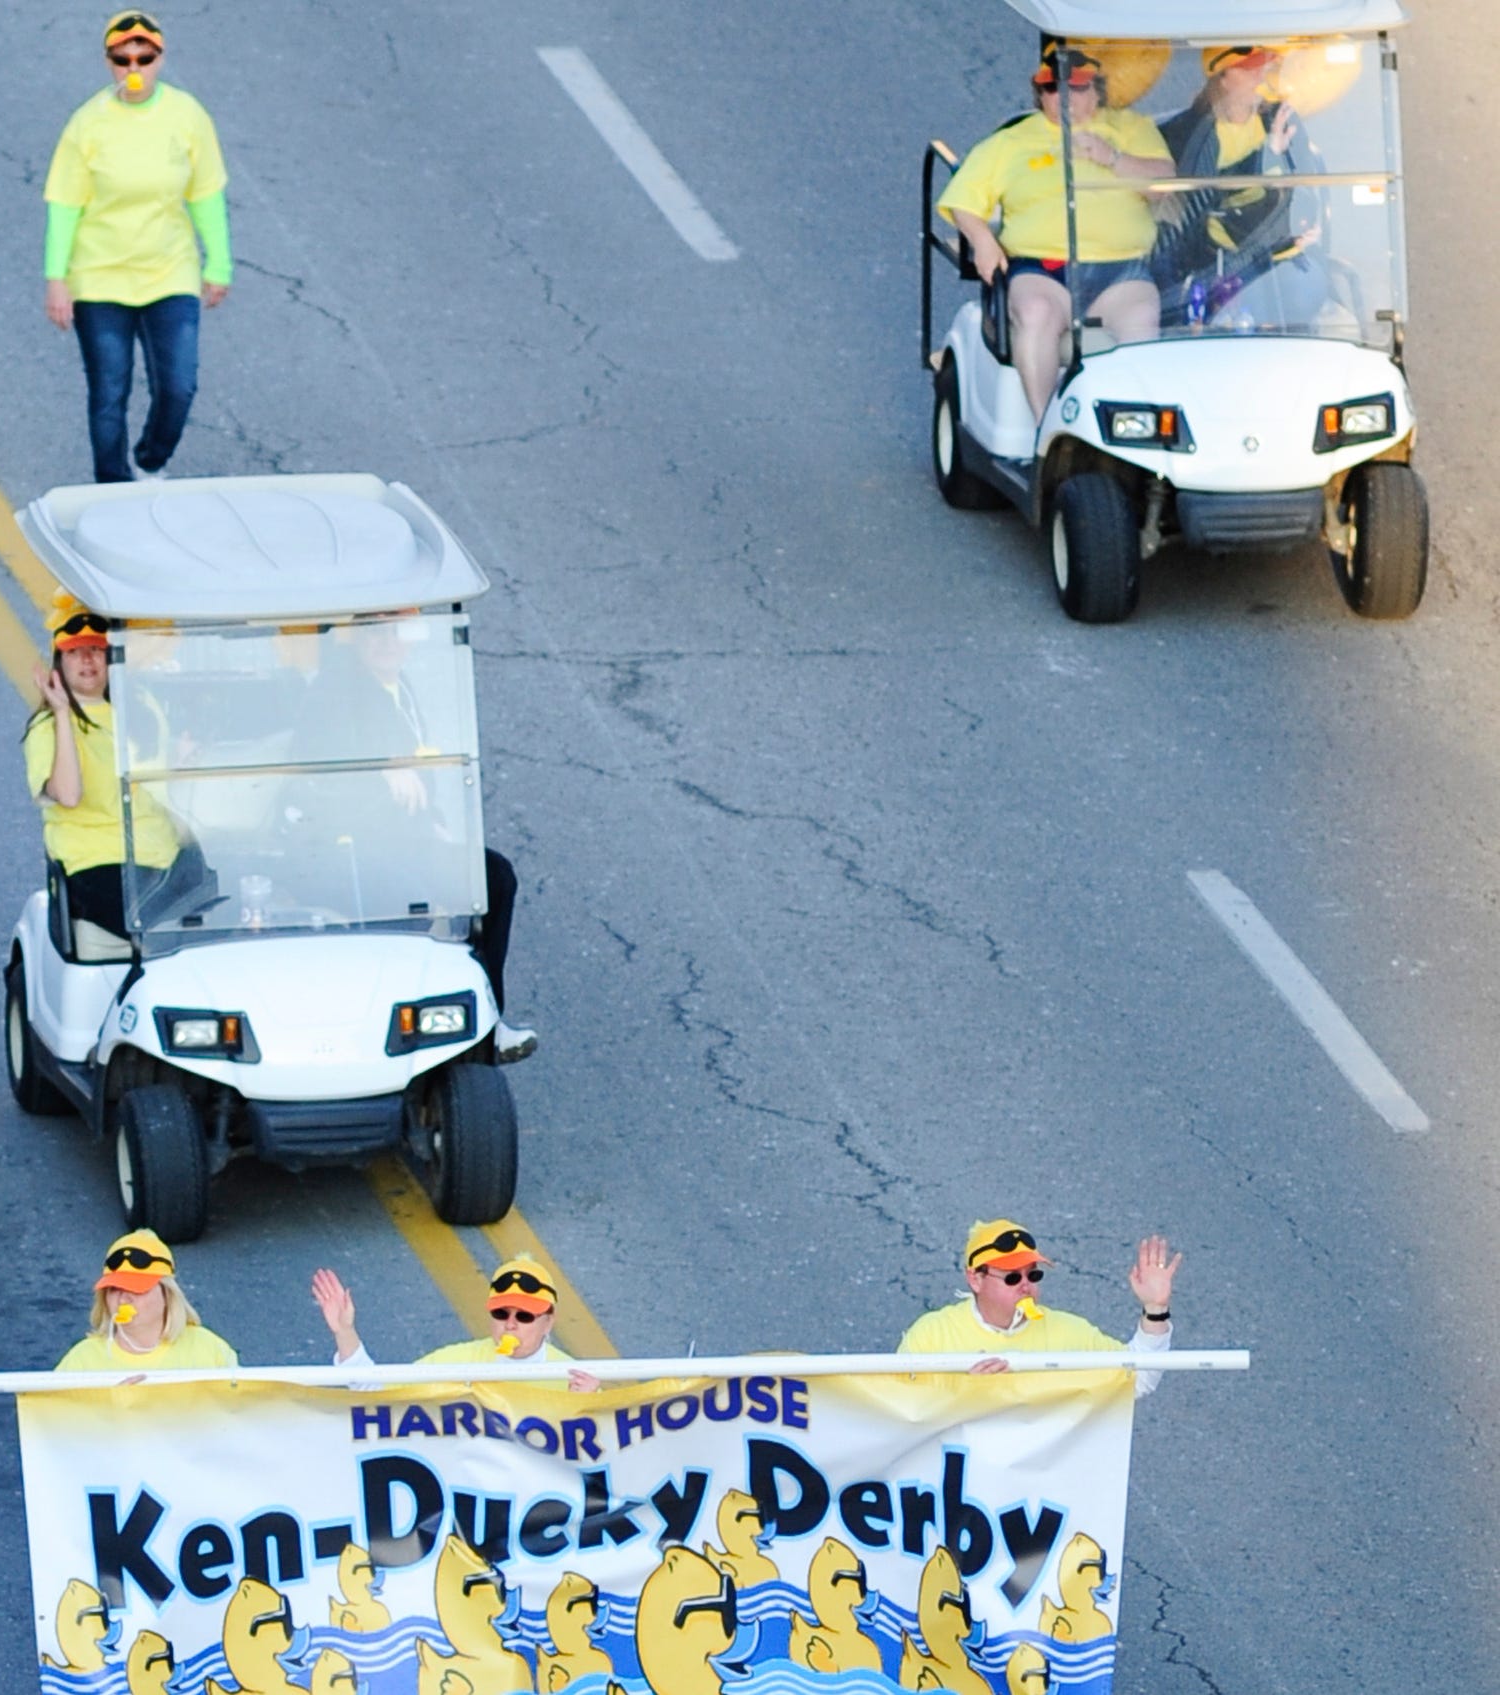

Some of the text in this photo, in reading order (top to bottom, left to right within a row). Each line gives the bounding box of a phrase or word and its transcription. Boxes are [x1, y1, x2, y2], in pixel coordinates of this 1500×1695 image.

[350, 1375, 810, 1462] HARBOR HOUSE
[85, 1436, 1068, 1613] Ken-Ducky Derby
